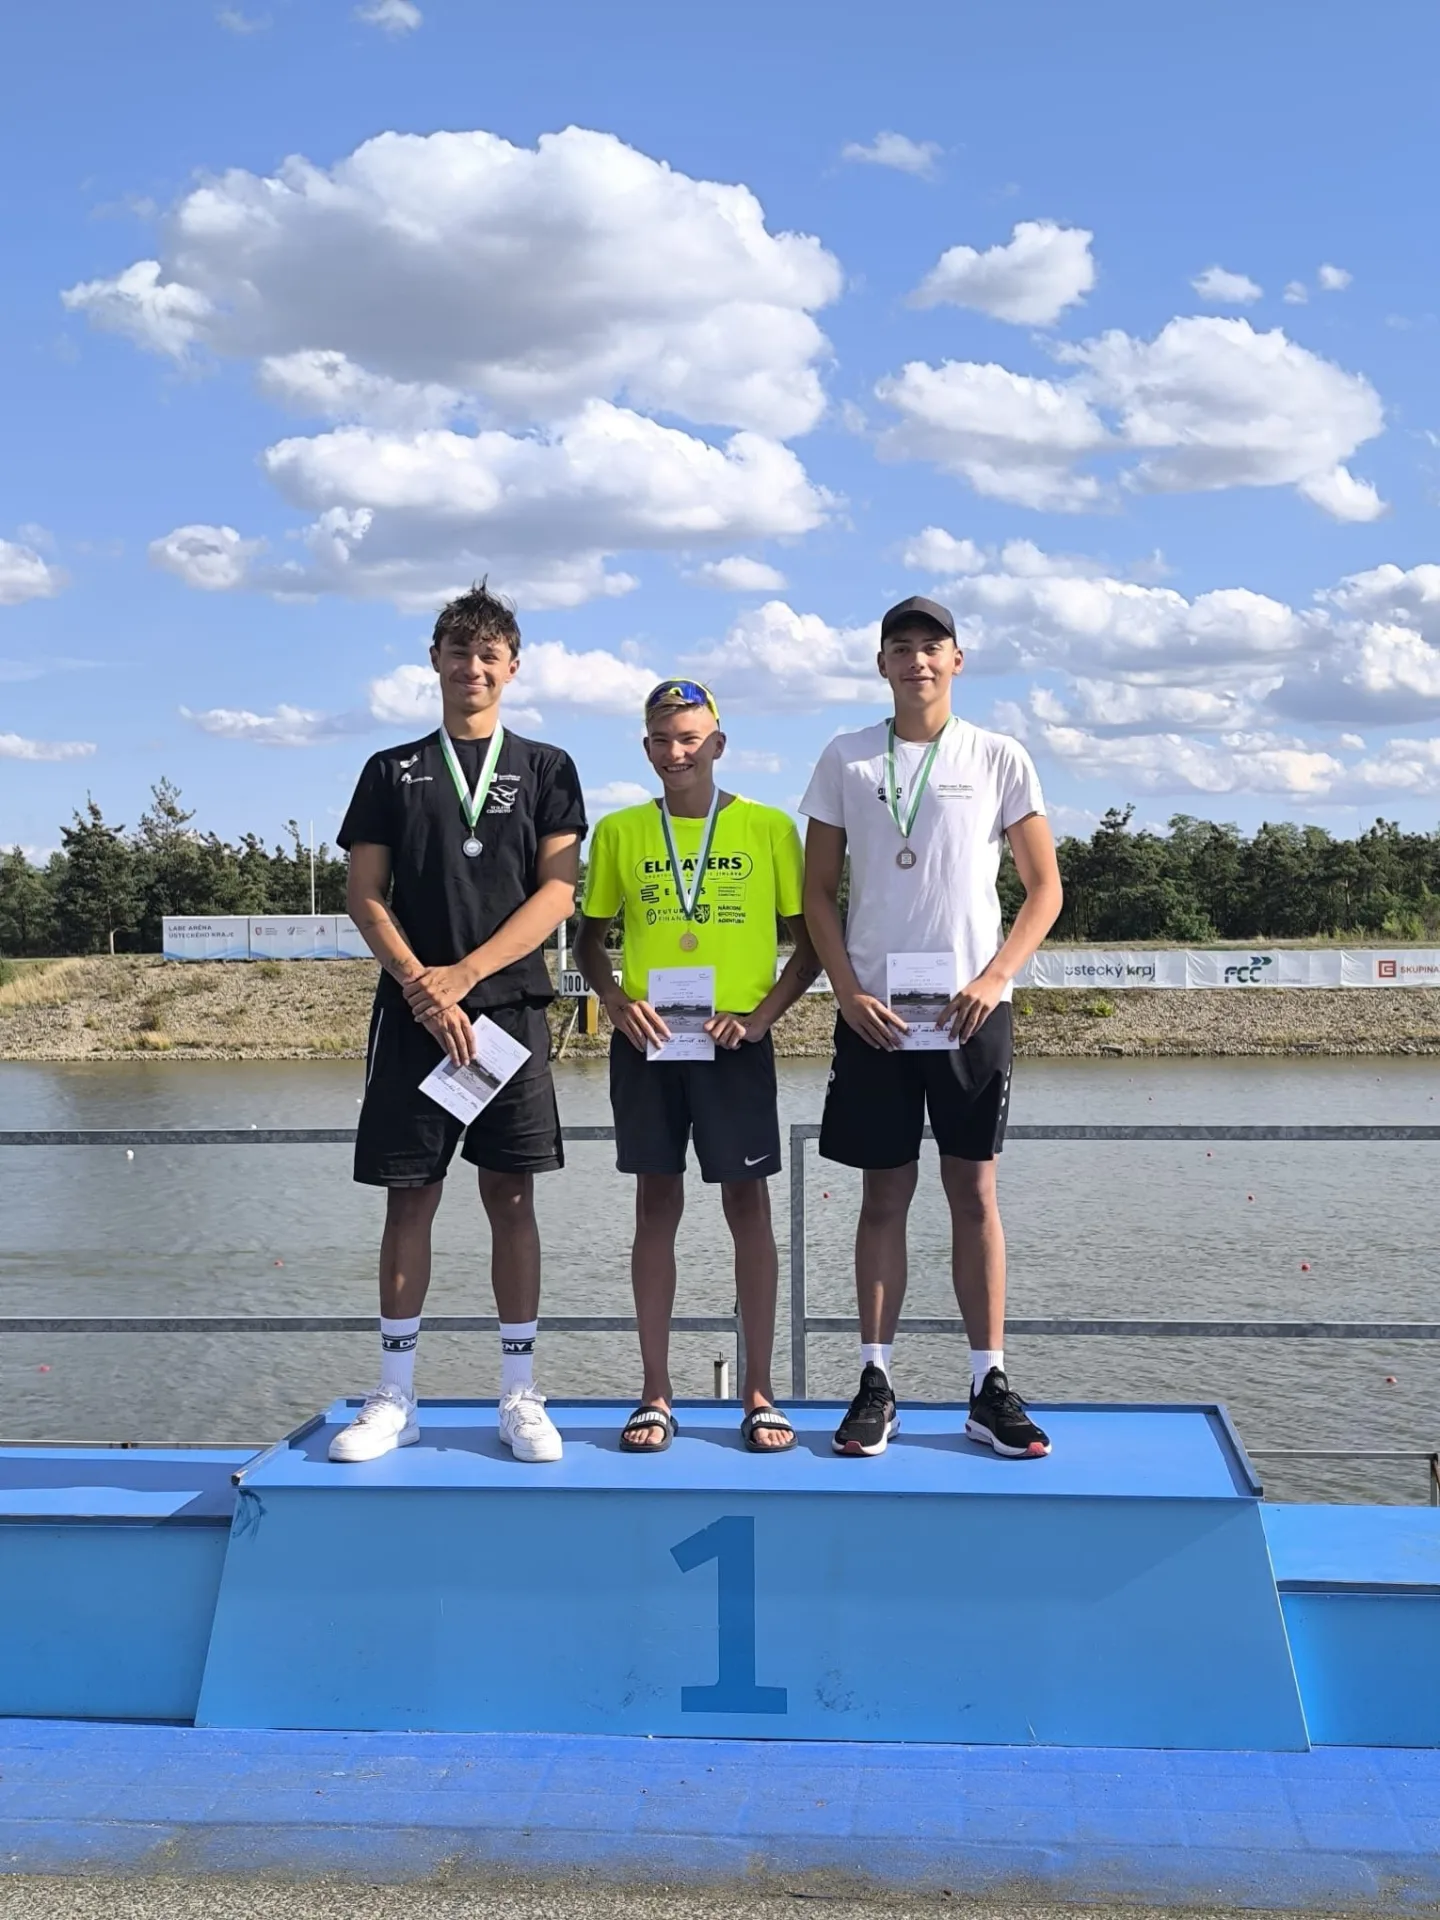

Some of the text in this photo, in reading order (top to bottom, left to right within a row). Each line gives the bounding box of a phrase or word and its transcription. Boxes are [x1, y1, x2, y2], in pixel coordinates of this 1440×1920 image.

[644, 857, 742, 873] ELIAERS
[1126, 962, 1156, 982] kraj
[1224, 966, 1262, 983] FCC
[1400, 966, 1439, 974] SKUPINA
[629, 1411, 667, 1425] PUMA
[670, 1516, 787, 1714] 1
